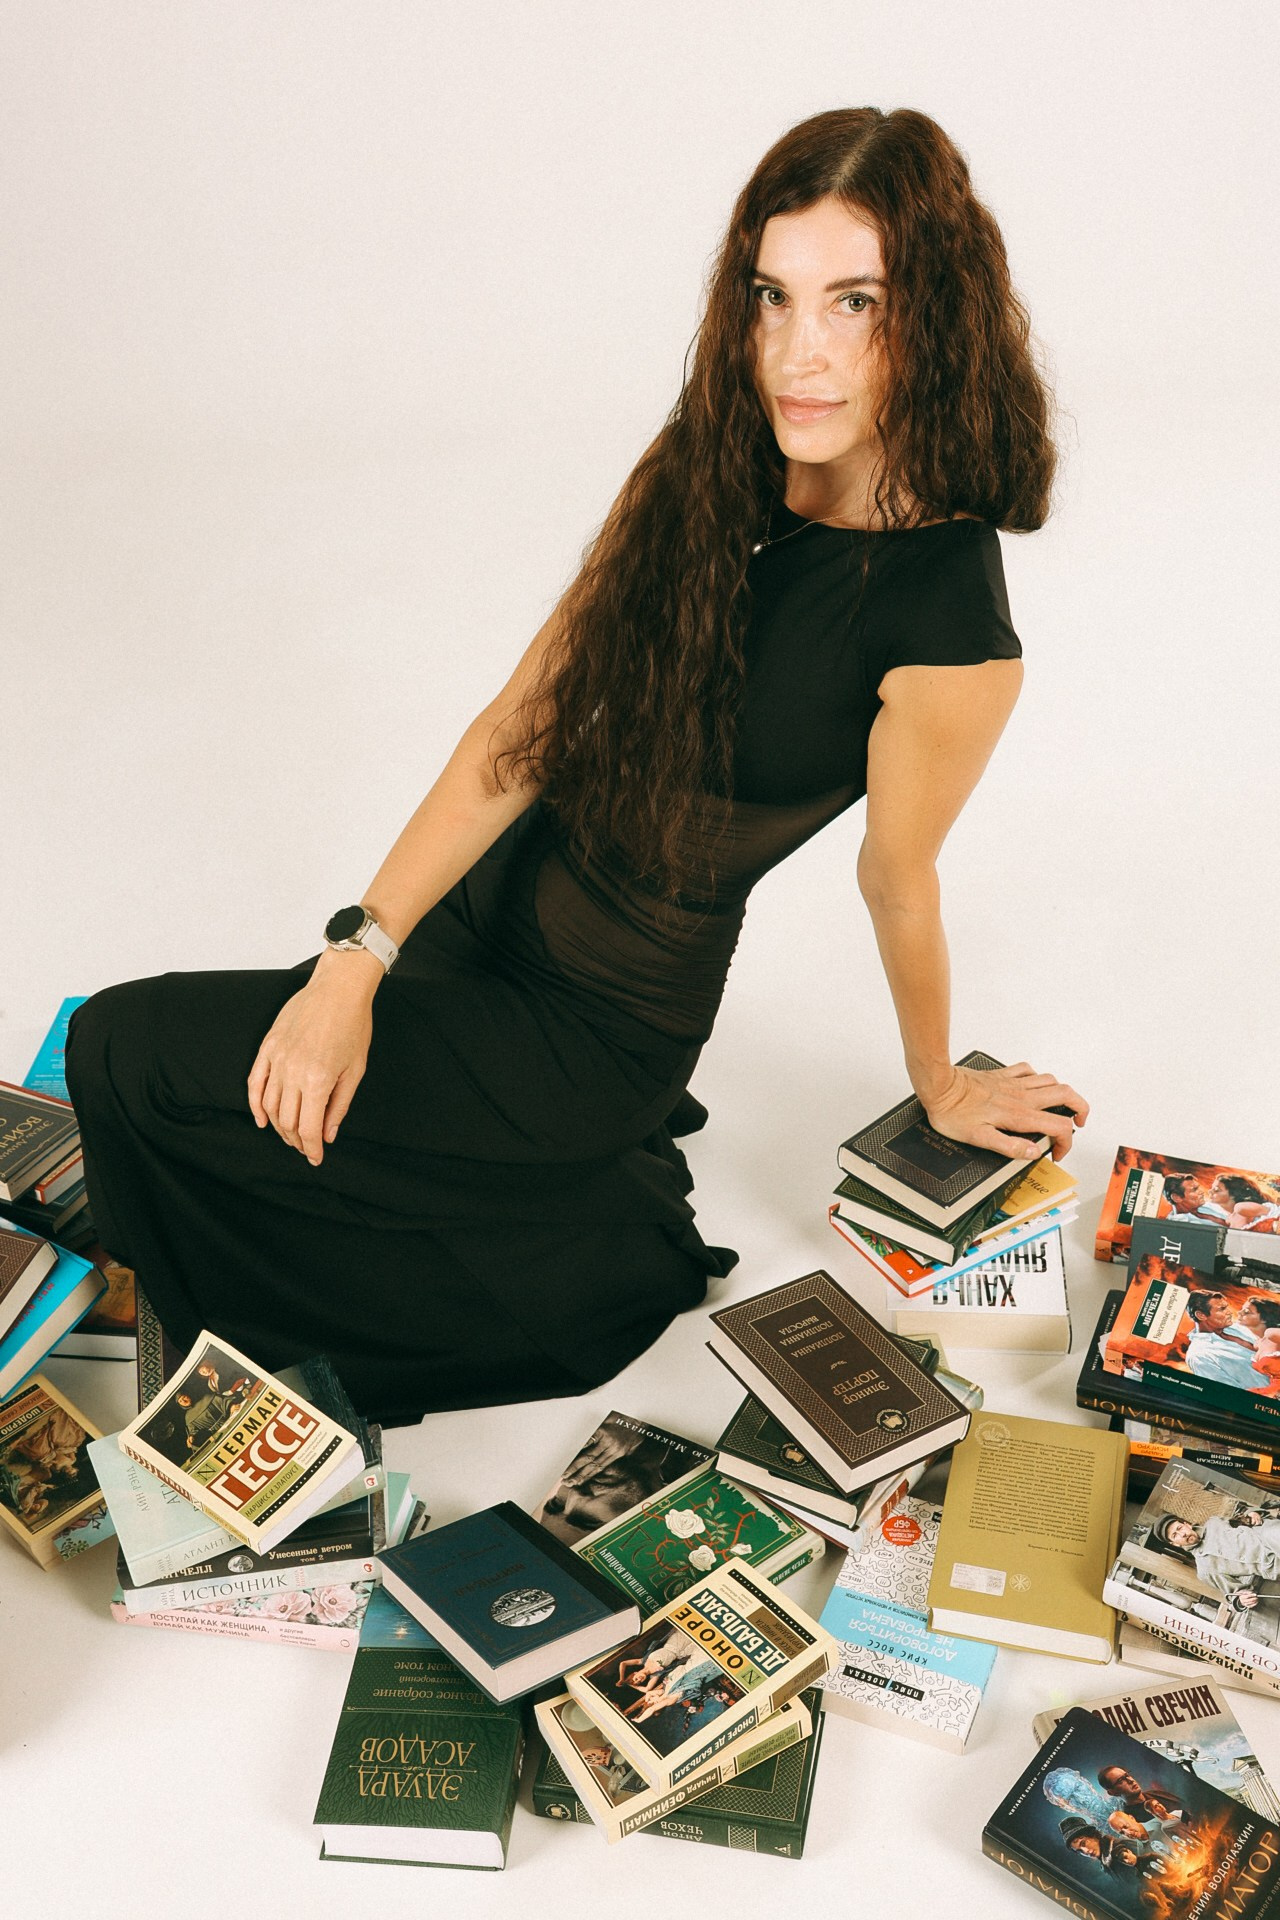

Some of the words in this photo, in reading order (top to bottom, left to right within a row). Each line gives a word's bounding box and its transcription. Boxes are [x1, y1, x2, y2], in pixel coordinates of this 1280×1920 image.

[1125, 1180, 1140, 1214] МИТЧЕЛЛ
[969, 1242, 1047, 1273] ЯНАГ
[933, 1275, 1016, 1307] ХАНЬЯ
[1143, 1292, 1161, 1326] МИТЧЕЛЛ
[778, 1315, 819, 1337] ВЫРОСЛА
[779, 1320, 834, 1348] ПОЛЛИАННА
[1153, 1311, 1170, 1340] Унесенные
[790, 1331, 845, 1359] ПОЛЛИАННА
[831, 1369, 879, 1397] ПОРТЕР
[841, 1378, 889, 1407] Элинор
[0, 1407, 41, 1436] ШОДЕРЛО
[214, 1391, 282, 1465] ГЕРМАН
[1091, 1397, 1192, 1432] АВИАТОР
[615, 1417, 687, 1453] Макконахи
[1199, 1429, 1241, 1443] ВОДОЛАЗКИН
[210, 1404, 316, 1508] ГЕССЕ
[1196, 1457, 1233, 1467] ОТПУСКАЙ
[1210, 1453, 1231, 1461] МЕНЯ
[246, 1492, 270, 1517] НАРЦИСС
[274, 1465, 299, 1492] ЗЛАТОУСТ
[893, 1519, 913, 1528] ФБР
[183, 1538, 224, 1560] АТЛАНТ
[268, 1547, 318, 1560] Унесенные
[322, 1543, 352, 1553] ветром
[598, 1547, 625, 1576] ВОЙНИЧ
[160, 1564, 213, 1579] ТЧЕЛЛ
[621, 1571, 649, 1598] ЛИЛИАН
[182, 1574, 288, 1601] ИСТОЧНИК
[150, 1613, 199, 1625] ПОСТУПАЙ
[200, 1619, 217, 1627] КАК
[221, 1621, 270, 1634] ЖЕНЩИНА,
[153, 1621, 184, 1629] ДУМАЙ
[205, 1628, 250, 1637] МУЖЧИНА
[695, 1591, 764, 1654] БАЛЬЗАК
[860, 1608, 932, 1638] ПРОБЛЕМА
[1162, 1615, 1231, 1651] ЖИЗНИ
[675, 1607, 745, 1670] ОНОРЕ
[848, 1619, 957, 1662] ДОГОВОРИТЬСЯ
[867, 1638, 894, 1654] ВОСС
[936, 1634, 955, 1648] НЕ
[1140, 1622, 1254, 1680] ПРИВАЛОВСКИЕ
[1234, 1646, 1246, 1658] В
[394, 1661, 424, 1671] томе
[754, 1644, 785, 1672] ДЕ
[901, 1650, 928, 1666] КРИС
[848, 1669, 886, 1686] ПОБЕДА
[894, 1682, 920, 1699] ПЛЮС
[373, 1686, 433, 1701] собрание
[1144, 1684, 1221, 1728] СВЕЧИН
[711, 1731, 726, 1748] ДЕ
[728, 1714, 755, 1742] ОНОРЕ
[359, 1733, 476, 1766] АСАДОВ
[674, 1746, 712, 1780] БАЛЬЗАК
[357, 1765, 463, 1801] ЭДУАРД
[686, 1772, 716, 1796] РИЧАРД
[625, 1785, 686, 1832] ФЕЙНМАН
[1008, 1793, 1027, 1816] ЧИТАЙТЕ
[660, 1820, 704, 1835] ЧЕХОВ
[663, 1830, 703, 1842] АНТОН
[1186, 1890, 1212, 1920] ЕНИЙ
[1208, 1823, 1255, 1892] ВОДОЛАЗКИН
